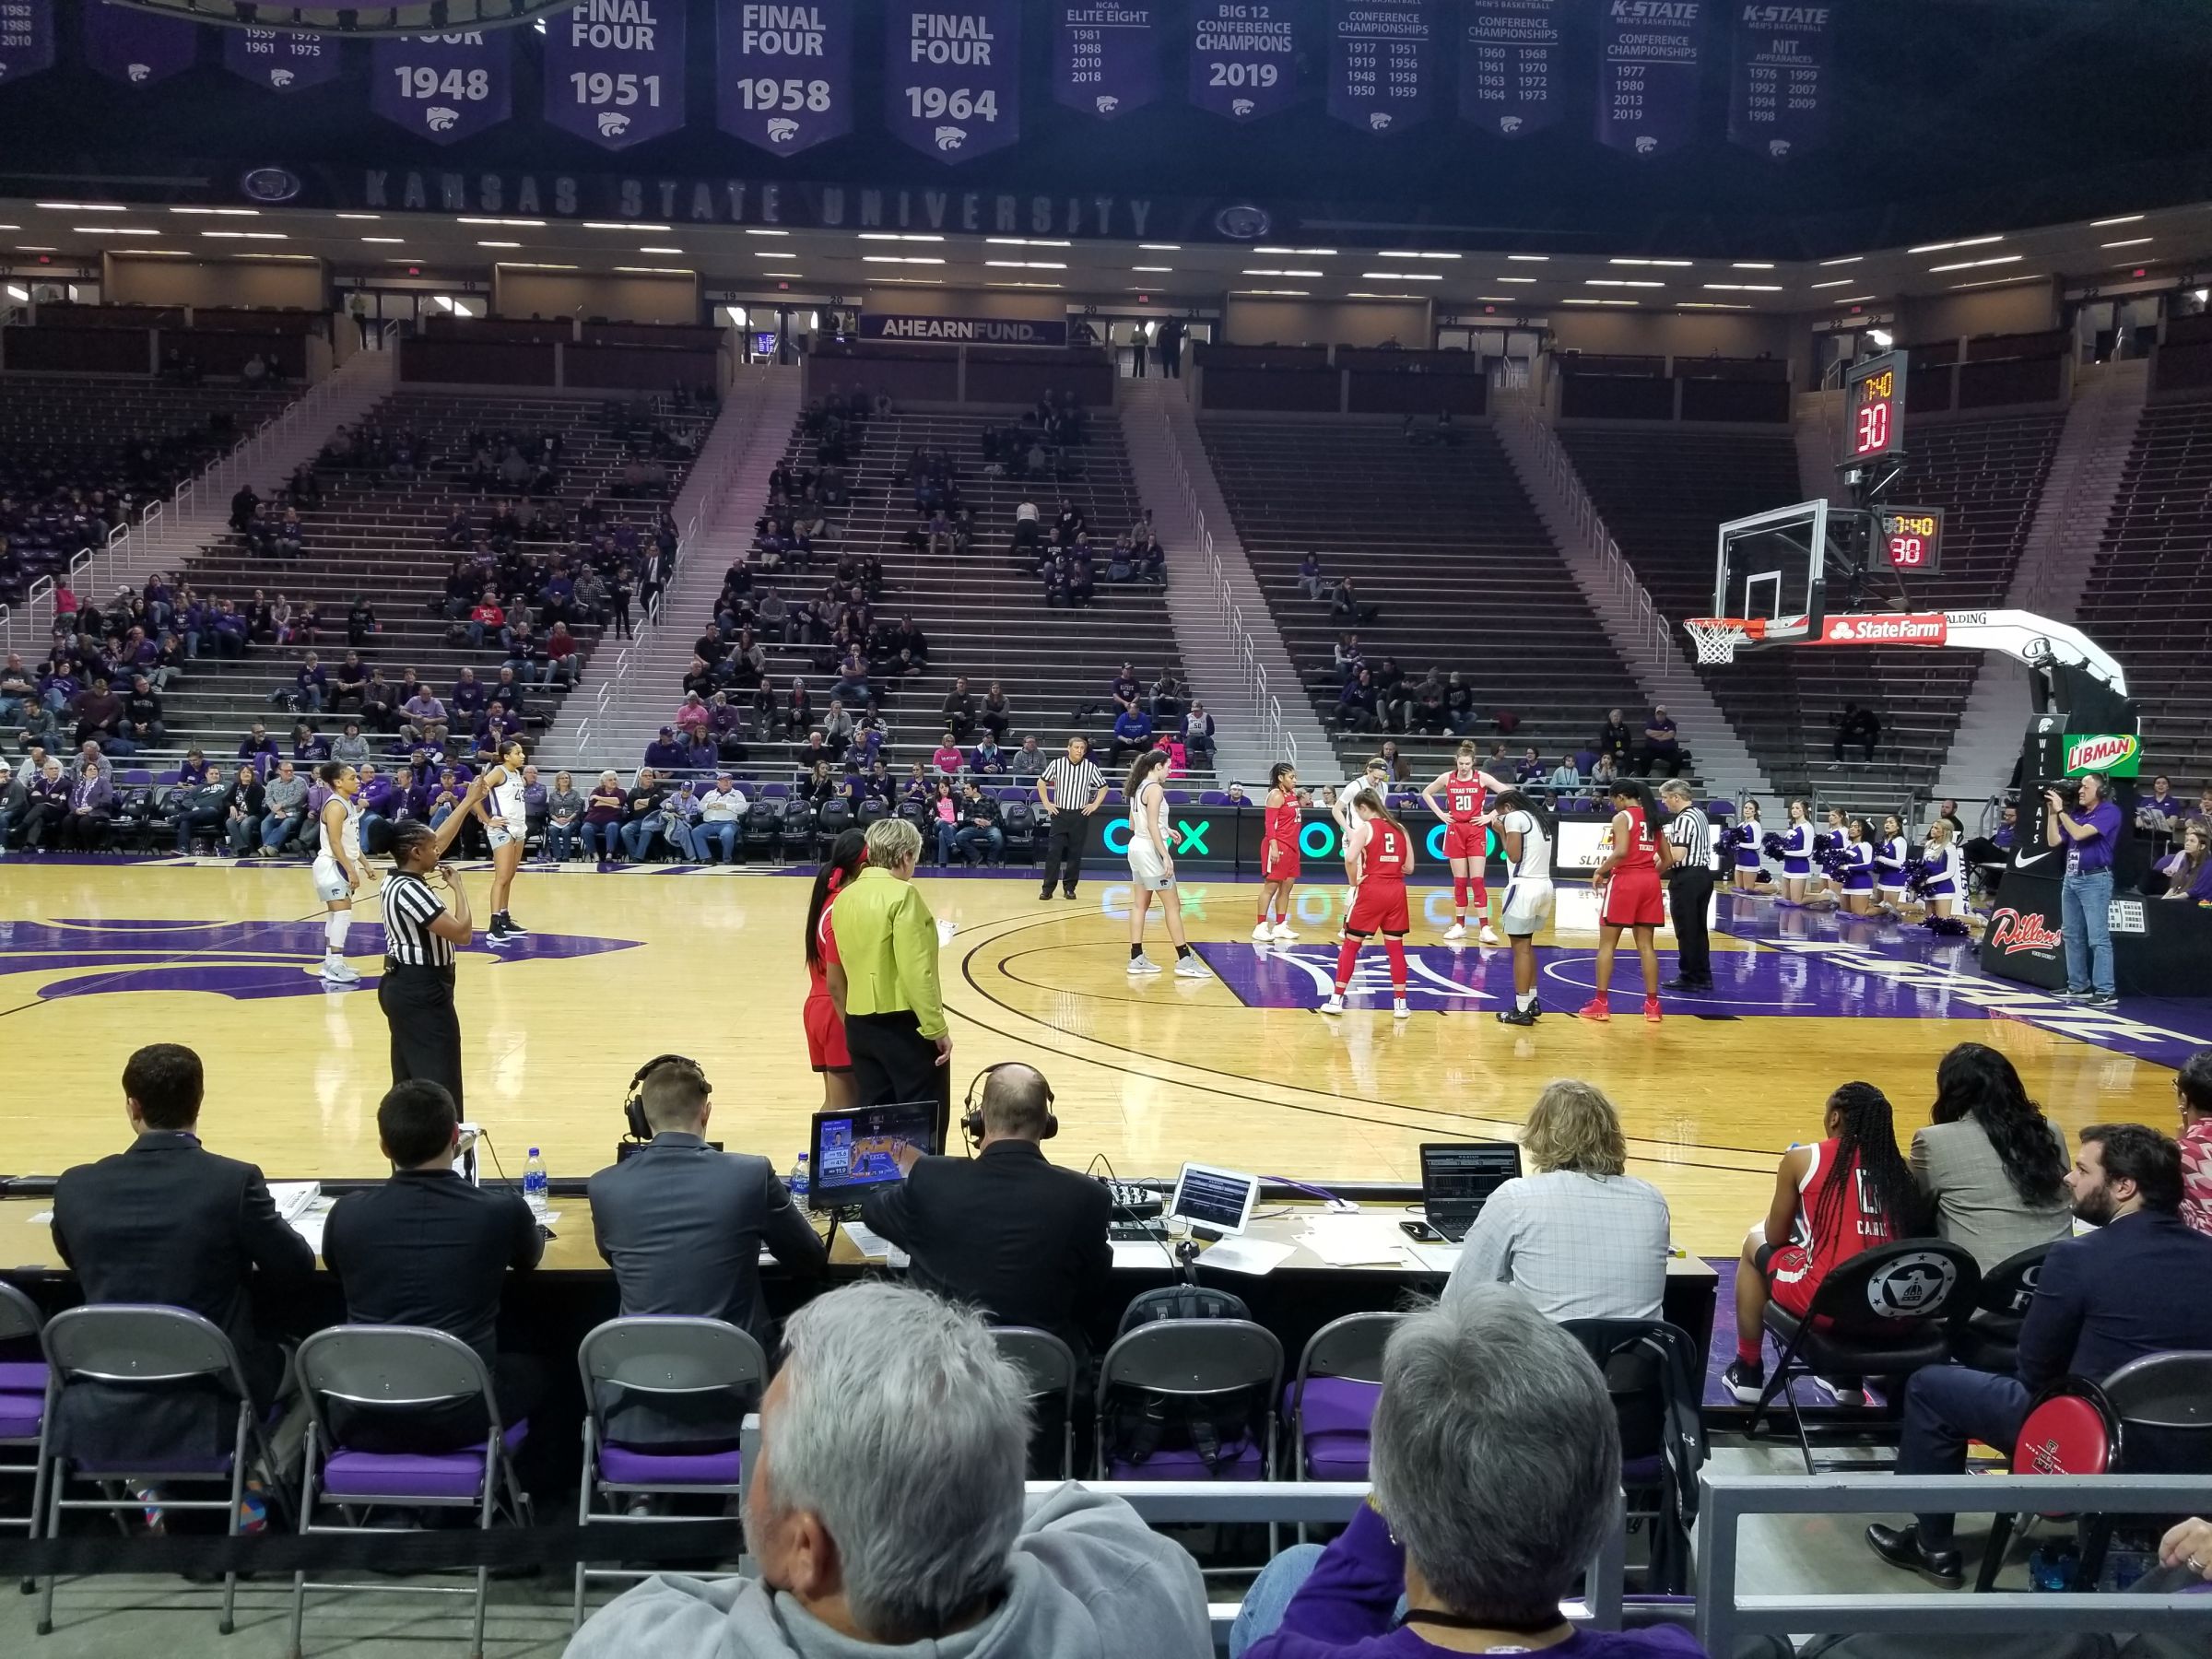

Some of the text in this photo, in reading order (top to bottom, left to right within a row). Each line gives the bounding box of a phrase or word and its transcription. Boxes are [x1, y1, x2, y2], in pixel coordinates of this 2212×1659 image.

[2, 6, 31, 16] 1982
[572, 0, 657, 25] FINAL
[1067, 9, 1149, 23] ELITE EIGHT
[1218, 6, 1269, 18] BIG 12
[1610, 1, 1700, 19] K-STATE
[1742, 6, 1830, 24] K-STATE
[743, 5, 827, 30] FINAL
[1349, 11, 1419, 24] CONFERENCE
[1478, 17, 1548, 29] CONFERENCE
[1617, 17, 1691, 27] MEN'S BASKETBALL
[2, 19, 31, 31] 1988
[912, 13, 994, 40] FINAL
[1197, 20, 1291, 34] CONFERENCE
[1338, 21, 1429, 35] CHAMPIONSHIPS
[1774, 23, 1822, 32] BASKETBALL
[571, 24, 654, 50] FOUR
[1073, 30, 1100, 40] 1981
[1468, 27, 1559, 39] CHAMPIONSHIPS
[2, 34, 31, 46] 2010
[742, 30, 823, 56] FOUR
[1195, 34, 1292, 52] CHAMPIONS
[1619, 34, 1688, 46] CONFERENCE
[244, 41, 321, 56] 1961 1975
[911, 40, 991, 65] FOUR
[1073, 44, 1101, 53] 1988
[1347, 42, 1417, 54] 1917 1951
[1607, 44, 1697, 57] CHAMPIONSHIPS
[1772, 40, 1799, 53] NIT
[1477, 47, 1547, 59] 1960 1968
[1756, 53, 1813, 64] APPEARANCES
[1072, 58, 1101, 67] 2010
[1347, 57, 1418, 68] 1919 1956
[1477, 62, 1547, 73] 1961 1970
[1072, 72, 1101, 82] 2018
[1209, 63, 1278, 87] 2019
[1347, 71, 1418, 83] 1948 1958
[1617, 66, 1645, 77] 1977
[1749, 68, 1818, 80] 1976 1999
[394, 65, 488, 100] 1948
[1477, 76, 1547, 87] 1963 1972
[1616, 80, 1644, 91] 1980
[571, 72, 660, 107] 1951
[737, 78, 830, 112] 1958
[1347, 85, 1417, 97] 1950 1959
[1477, 89, 1547, 100] 1964 1973
[1749, 83, 1817, 95] 1992 2007
[905, 87, 997, 122] 1964
[1614, 95, 1643, 105] 2013
[1748, 97, 1817, 109] 1994 2009
[1613, 109, 1642, 120] 2019
[1747, 111, 1775, 122] 1998
[366, 169, 1152, 236] KANSAS STATE UNIVERSITY
[724, 291, 736, 301] 19
[830, 296, 843, 305] 20
[1084, 305, 1098, 315] 20
[1865, 371, 1892, 401] 7:40
[1858, 403, 1887, 452] 30
[1895, 515, 1934, 535] 7:40
[1891, 538, 1920, 563] 30
[1946, 612, 1986, 625] ALDING
[2067, 738, 2130, 771] LIBMAN
[2033, 738, 2046, 843] WILATS
[1455, 795, 1472, 811] 20
[1103, 818, 1210, 854] CX
[1384, 833, 1394, 853] 2
[1992, 908, 2063, 949] Dillons
